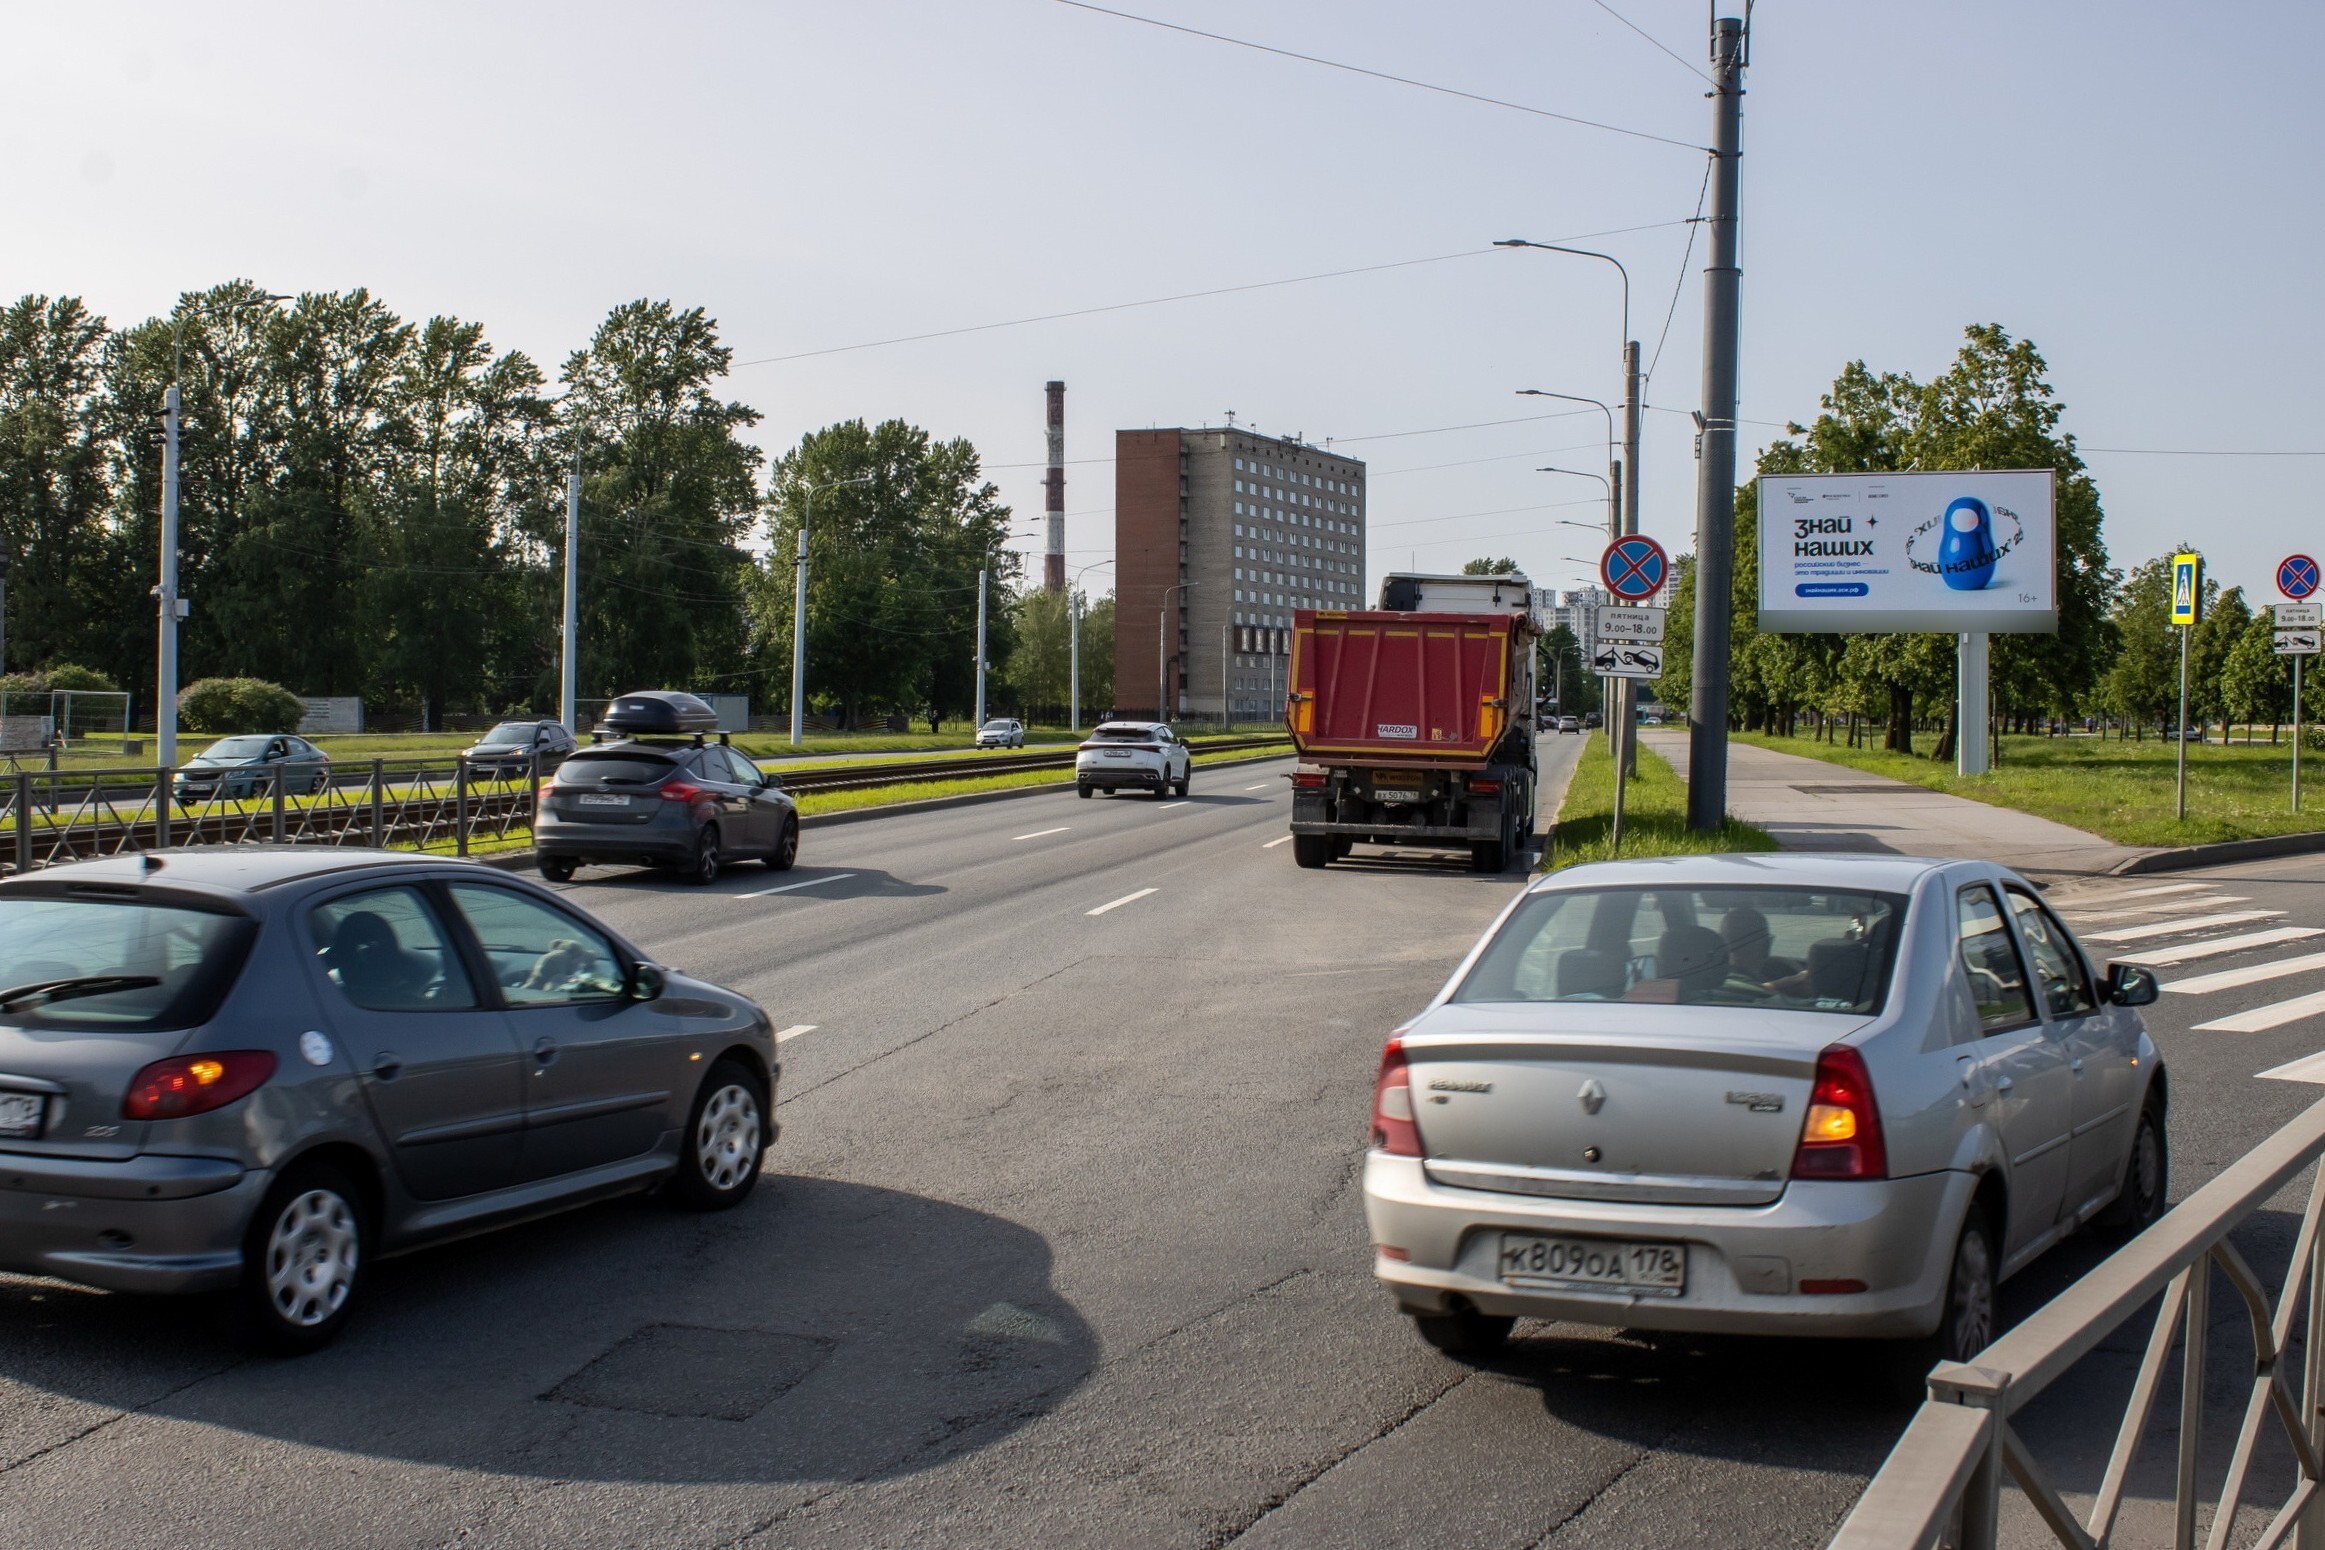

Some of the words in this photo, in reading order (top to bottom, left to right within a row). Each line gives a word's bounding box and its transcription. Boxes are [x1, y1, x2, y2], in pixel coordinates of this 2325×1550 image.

[1794, 515, 1851, 539] знай
[1794, 540, 1874, 557] наших
[1794, 561, 1835, 569] российский
[1836, 560, 1861, 569] бизнес
[2018, 593, 2038, 603] 16+
[1610, 612, 1650, 621] пятница
[1377, 725, 1413, 734] HARDOX
